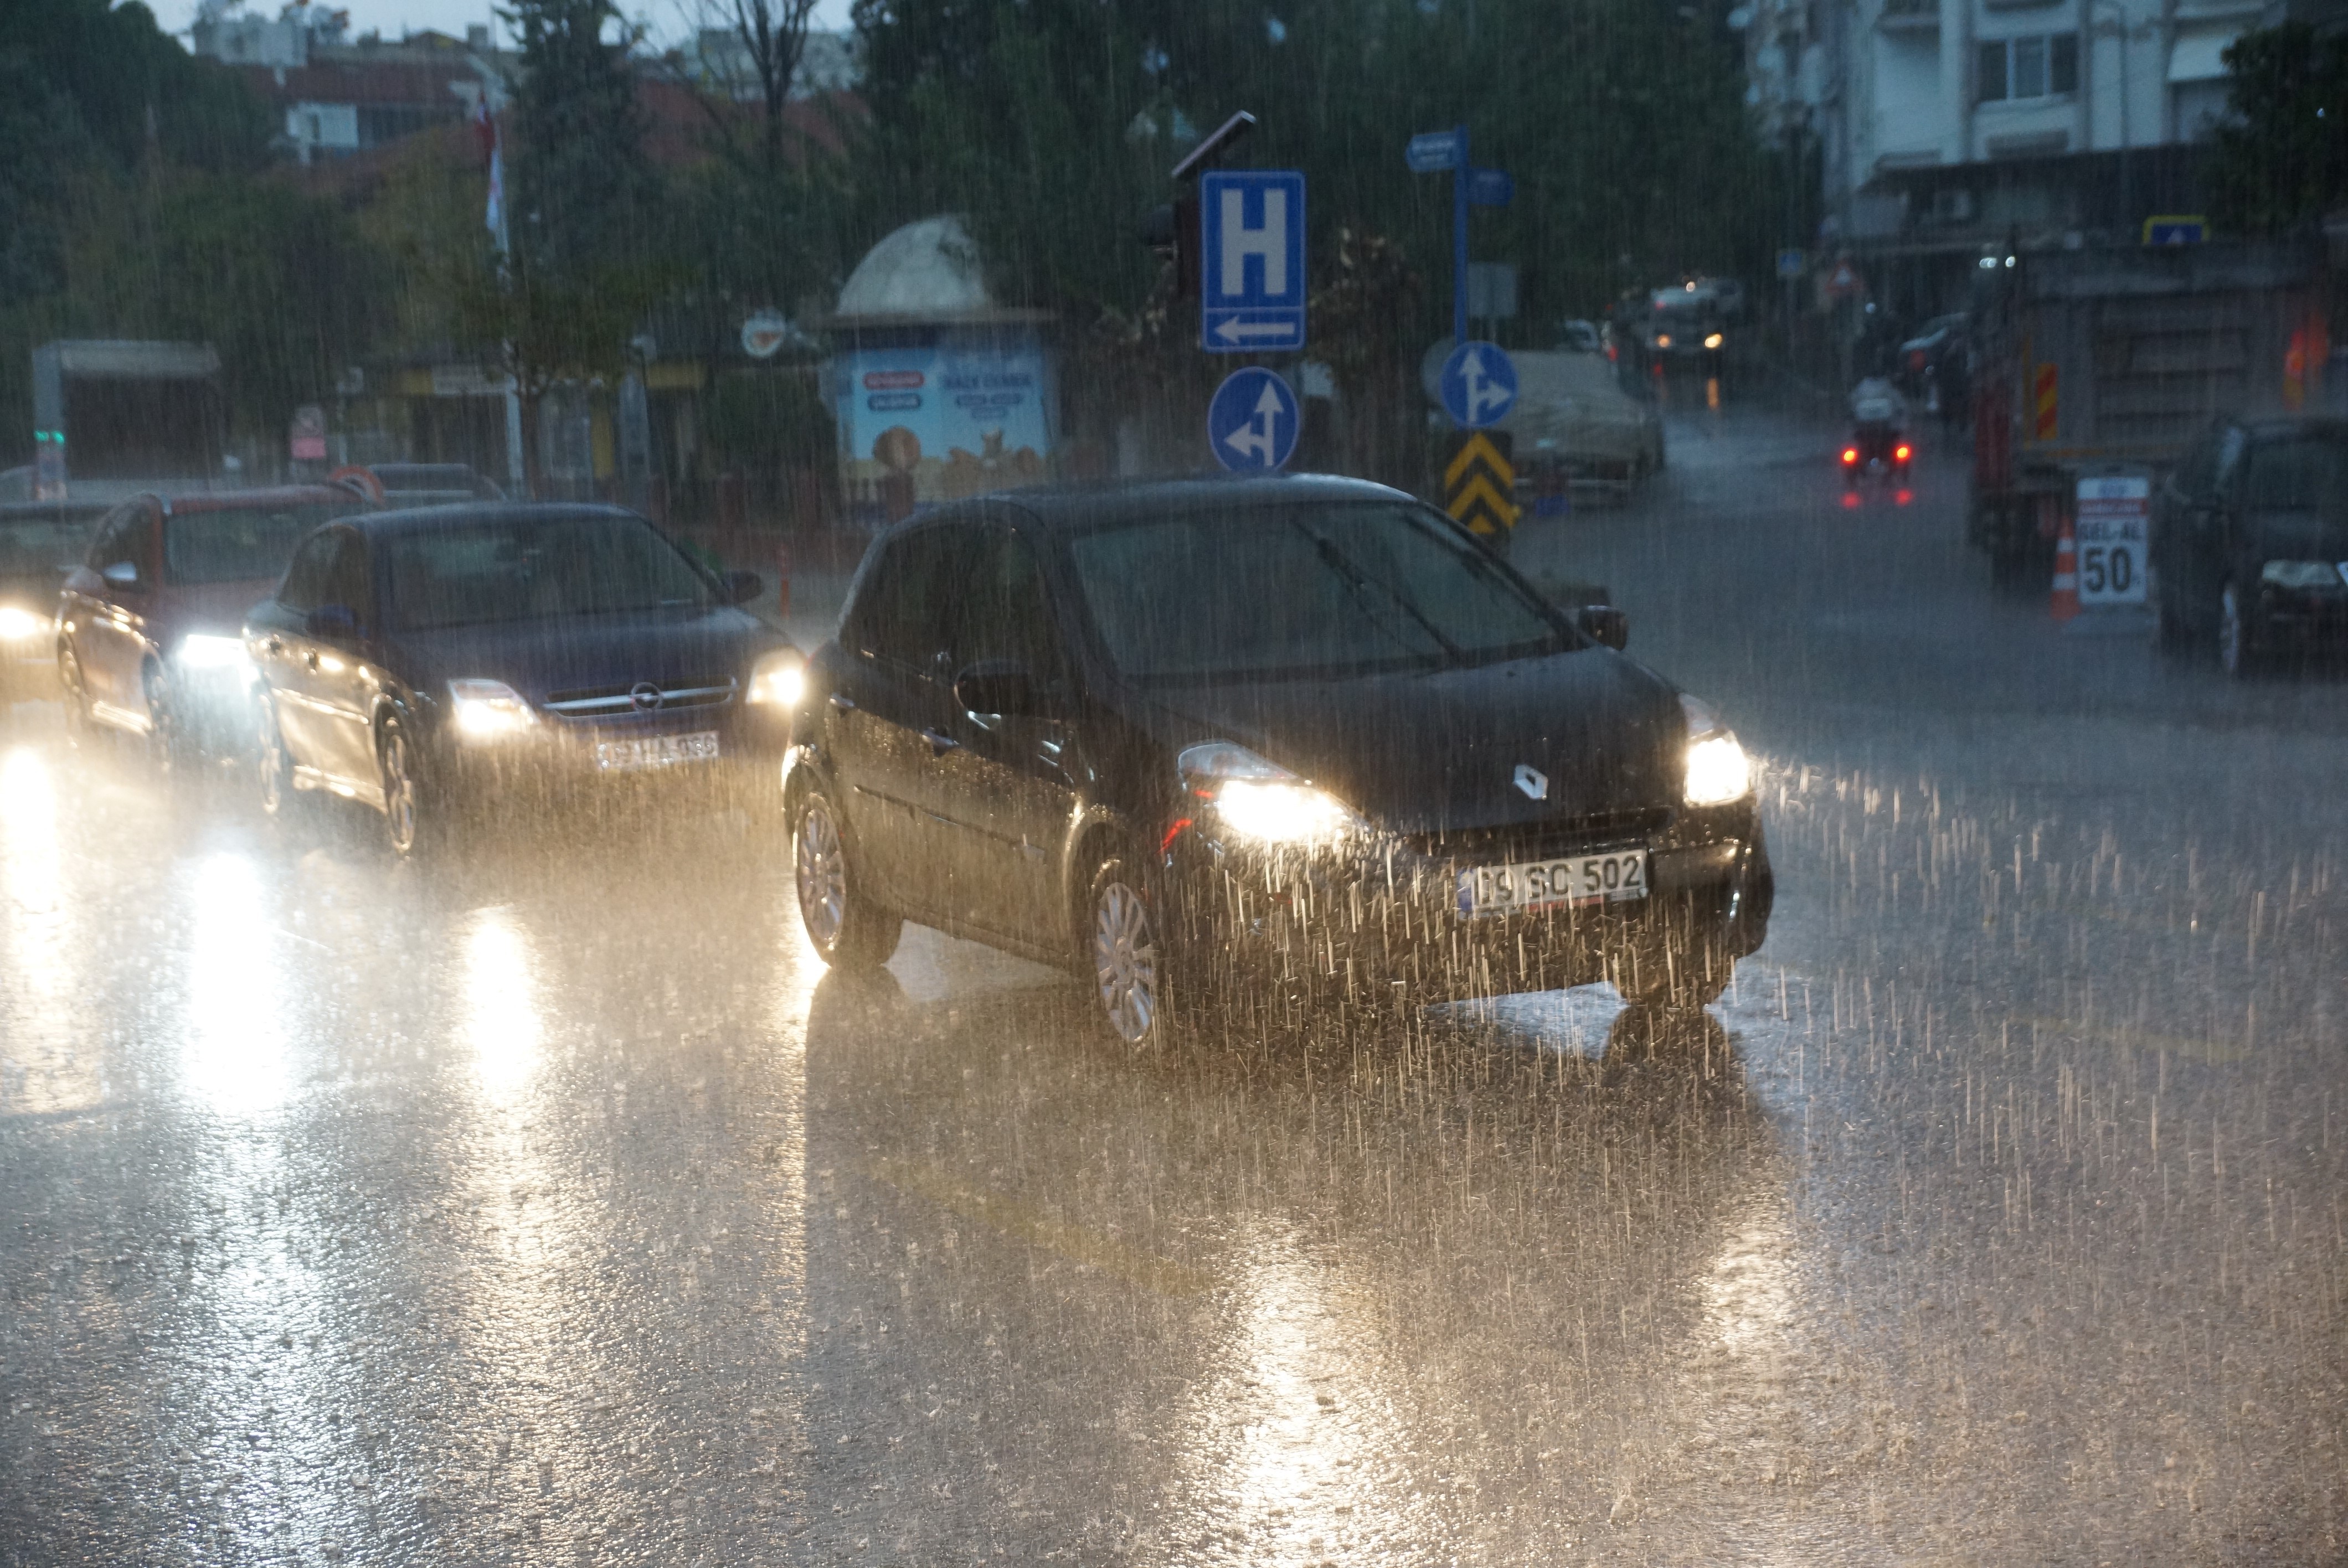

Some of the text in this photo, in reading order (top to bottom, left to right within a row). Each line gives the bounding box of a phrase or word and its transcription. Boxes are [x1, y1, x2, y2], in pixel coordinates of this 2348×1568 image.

[1220, 188, 1288, 296] H
[2084, 545, 2132, 593] 50
[1525, 862, 1573, 898] SC
[1583, 854, 1641, 891] 502
